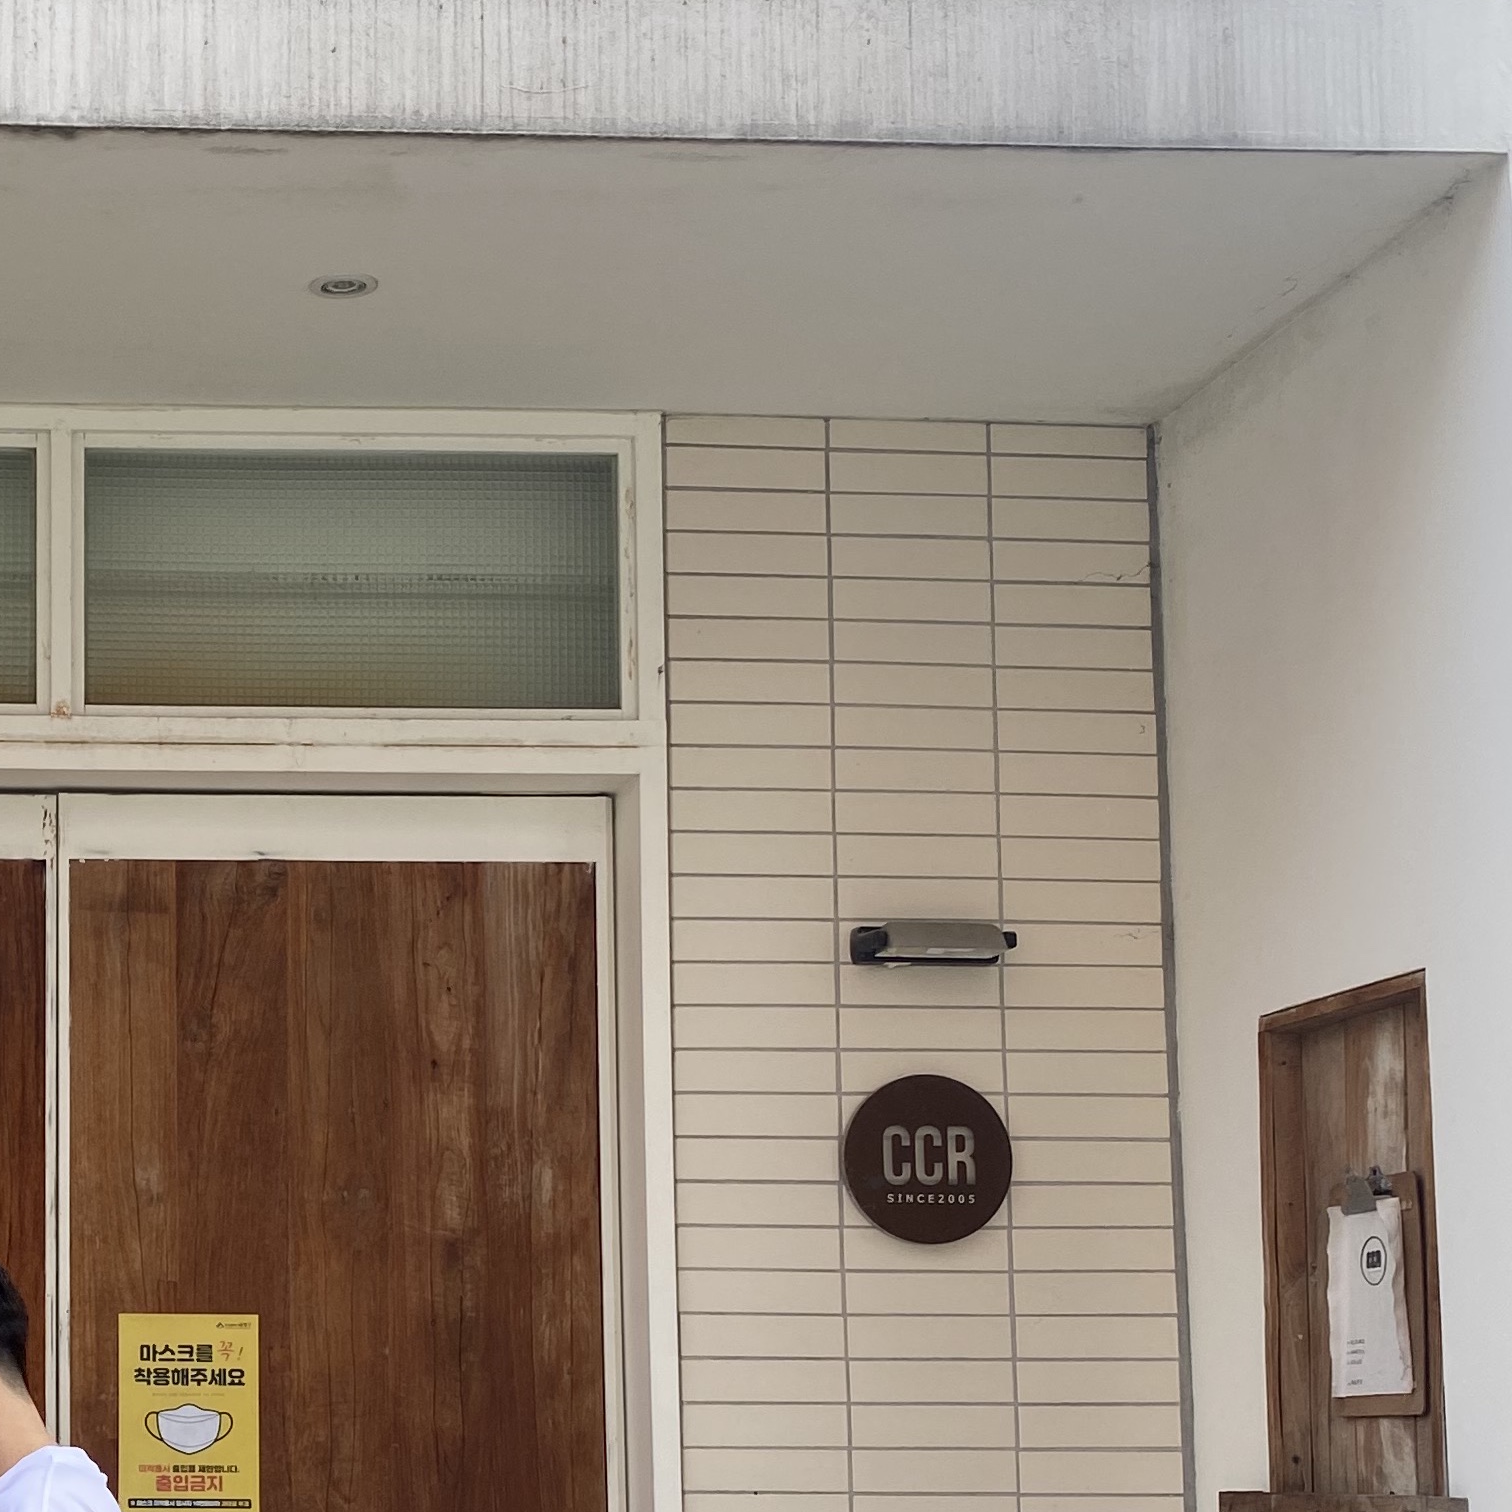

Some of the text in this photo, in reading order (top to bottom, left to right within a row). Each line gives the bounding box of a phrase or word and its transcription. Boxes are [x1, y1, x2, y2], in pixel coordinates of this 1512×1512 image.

[882, 1124, 977, 1187] CCR
[886, 1193, 976, 1204] SINCE2005
[139, 1344, 213, 1363] 마스크를
[134, 1367, 245, 1386] 착용해주세요
[156, 1474, 223, 1492] 출입금지
